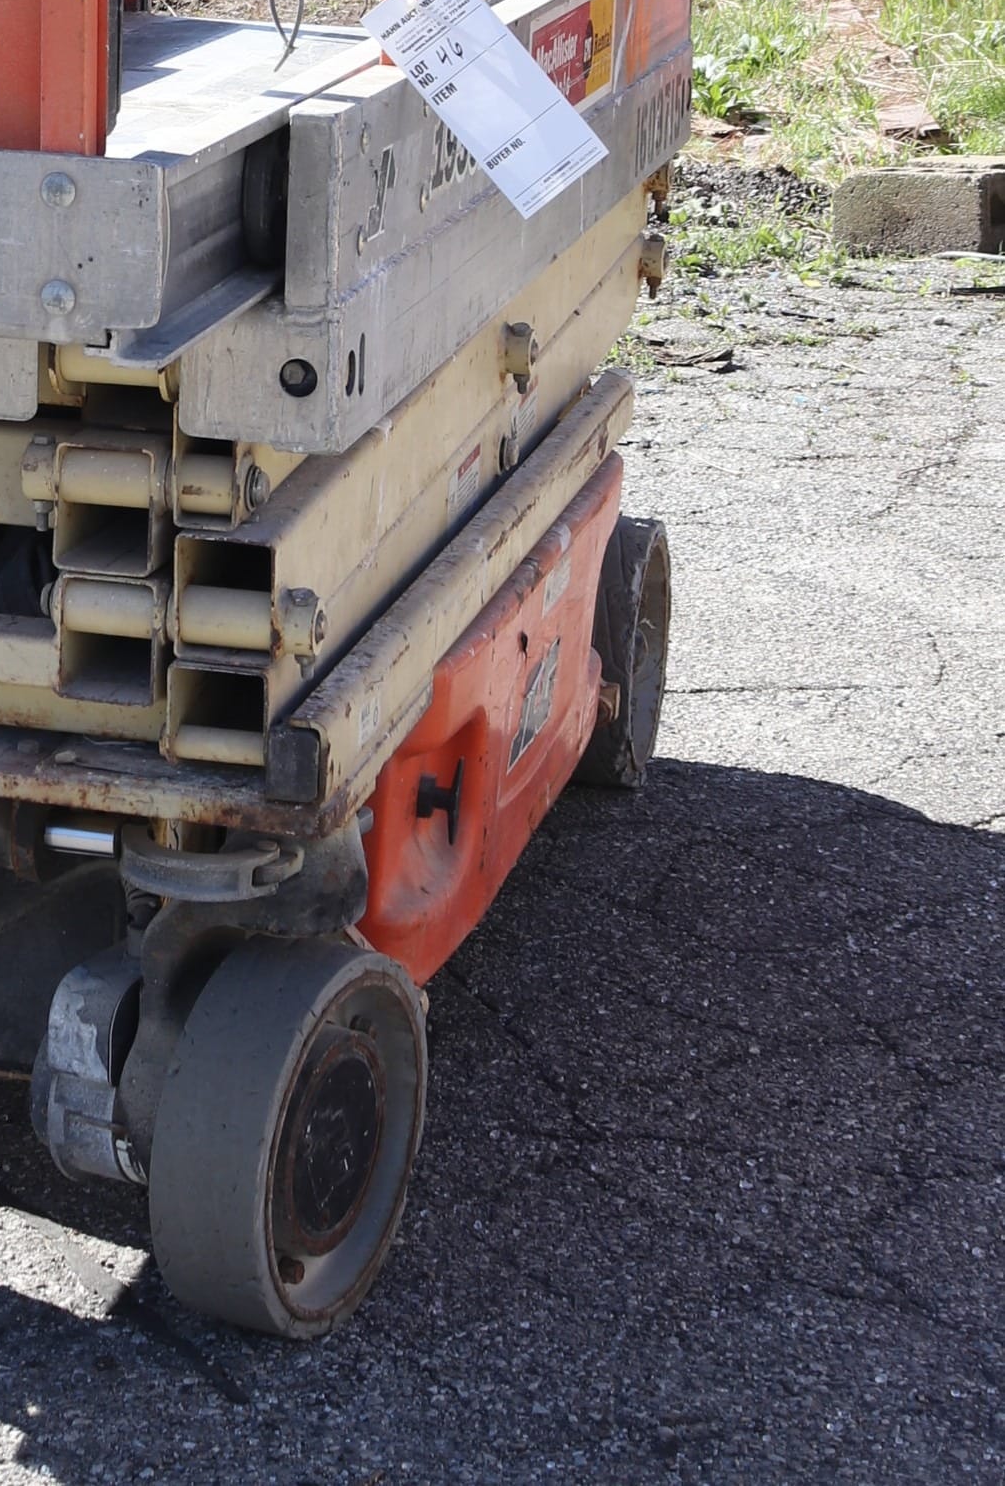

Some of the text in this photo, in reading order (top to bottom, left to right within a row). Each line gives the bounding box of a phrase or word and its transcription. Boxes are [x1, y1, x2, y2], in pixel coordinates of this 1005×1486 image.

[380, 22, 401, 41] HAHN
[435, 37, 464, 66] 46
[409, 60, 429, 79] LOT
[418, 72, 438, 89] NO.
[431, 82, 458, 106] ITEM
[486, 137, 526, 170] BUYER NO.
